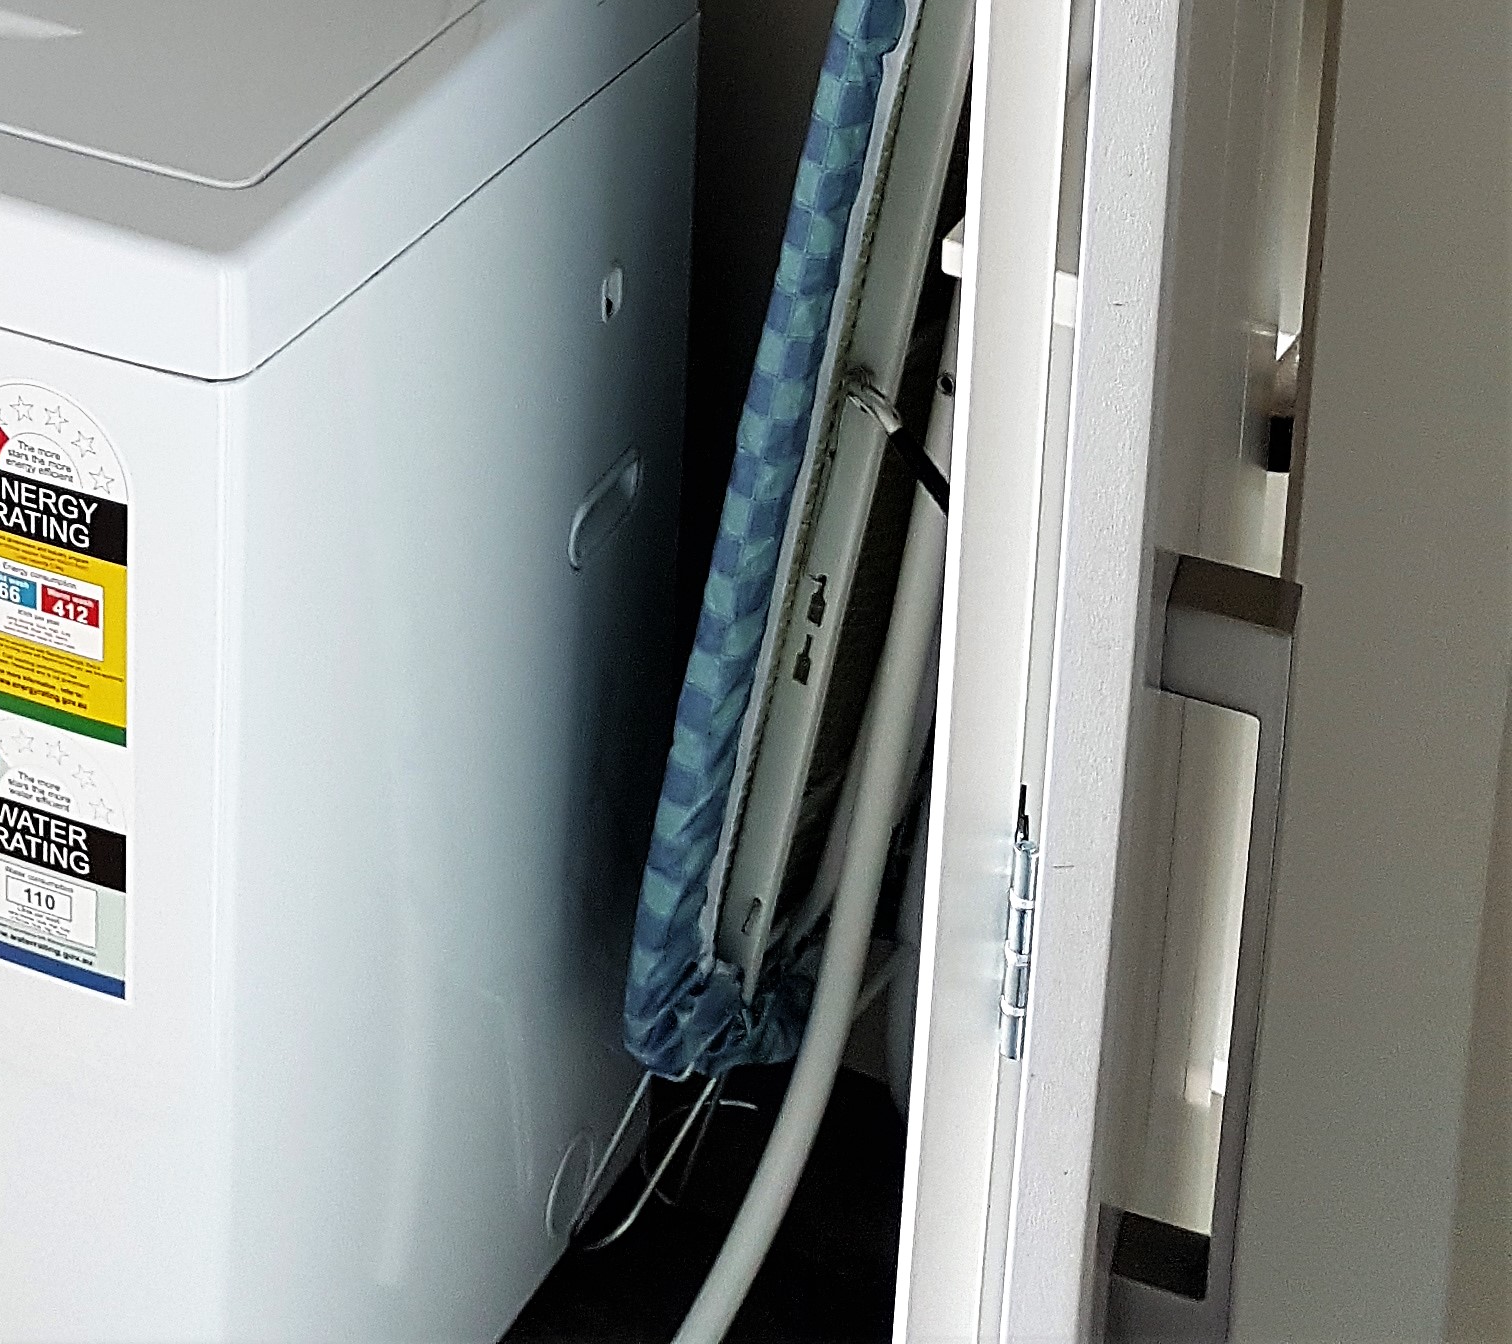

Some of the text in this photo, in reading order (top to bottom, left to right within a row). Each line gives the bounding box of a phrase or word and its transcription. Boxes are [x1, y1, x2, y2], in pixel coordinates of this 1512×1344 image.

[17, 439, 35, 454] The
[52, 599, 89, 625] 412
[23, 887, 56, 911] 110
